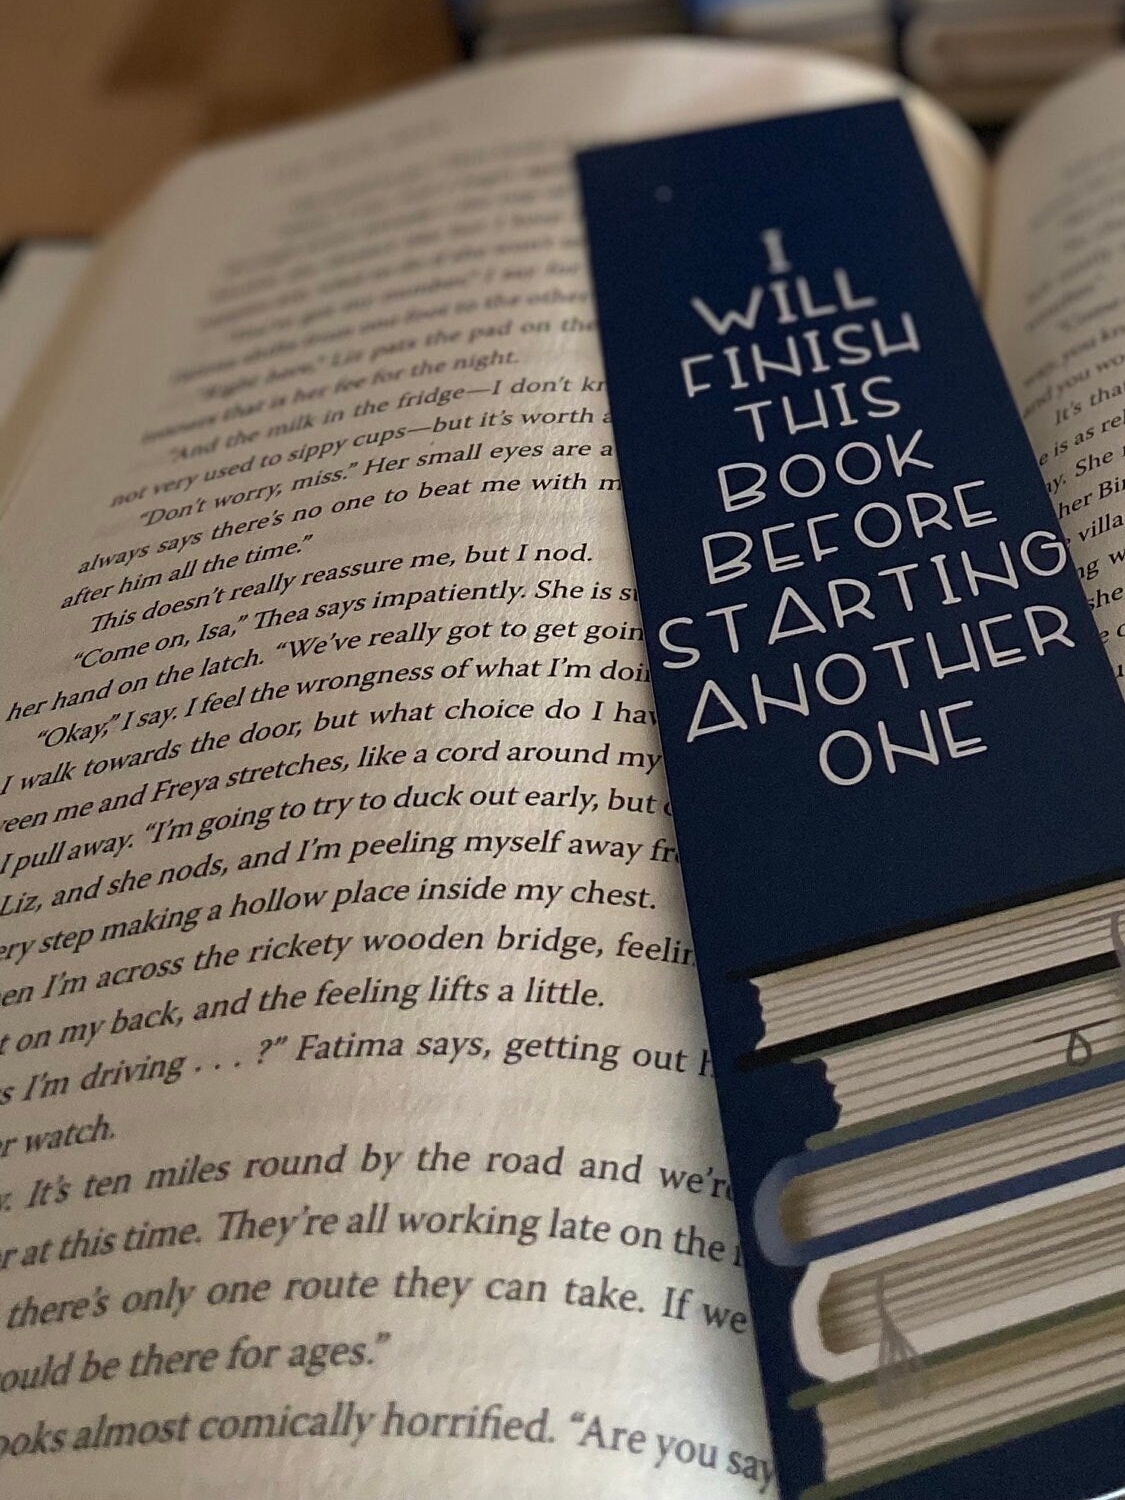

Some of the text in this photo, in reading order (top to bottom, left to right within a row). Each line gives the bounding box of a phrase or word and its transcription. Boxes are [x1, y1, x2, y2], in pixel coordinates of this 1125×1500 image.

[760, 227, 792, 274] I
[691, 267, 877, 336] WILL
[680, 311, 921, 399] FINISH
[733, 375, 901, 442] THIS
[216, 484, 281, 508] worry,
[363, 457, 410, 476] Her
[417, 442, 482, 467] small
[490, 445, 543, 463] eyes
[552, 445, 591, 456] are
[718, 429, 934, 513] BOOK
[702, 479, 998, 586] BEFORE
[61, 584, 115, 609] after
[118, 573, 162, 595] him
[168, 559, 198, 582] all
[202, 553, 239, 574] the
[91, 609, 137, 633] This
[229, 572, 296, 601] really
[301, 557, 403, 586] reassure
[410, 553, 455, 568] me,
[465, 544, 510, 564] but
[516, 543, 528, 561] I
[534, 543, 592, 563] nod.
[658, 530, 1068, 670] STARTING
[685, 605, 1076, 743] ANOTHER
[818, 700, 988, 786] ONE
[39, 875, 655, 954] step making a hollow place inside my chest.
[96, 956, 184, 989] across
[194, 943, 239, 971] the
[247, 933, 353, 963] rickety
[363, 924, 483, 952] wooden
[497, 924, 603, 961] bridge,
[84, 1173, 131, 1199] ten
[145, 1154, 231, 1190] miles
[243, 1143, 348, 1179] round
[361, 1142, 404, 1181] by
[416, 1141, 471, 1173] the
[485, 1145, 565, 1176] road
[579, 1153, 643, 1185] and
[77, 1349, 121, 1384] be
[129, 1342, 219, 1379] there
[225, 1334, 282, 1371] for
